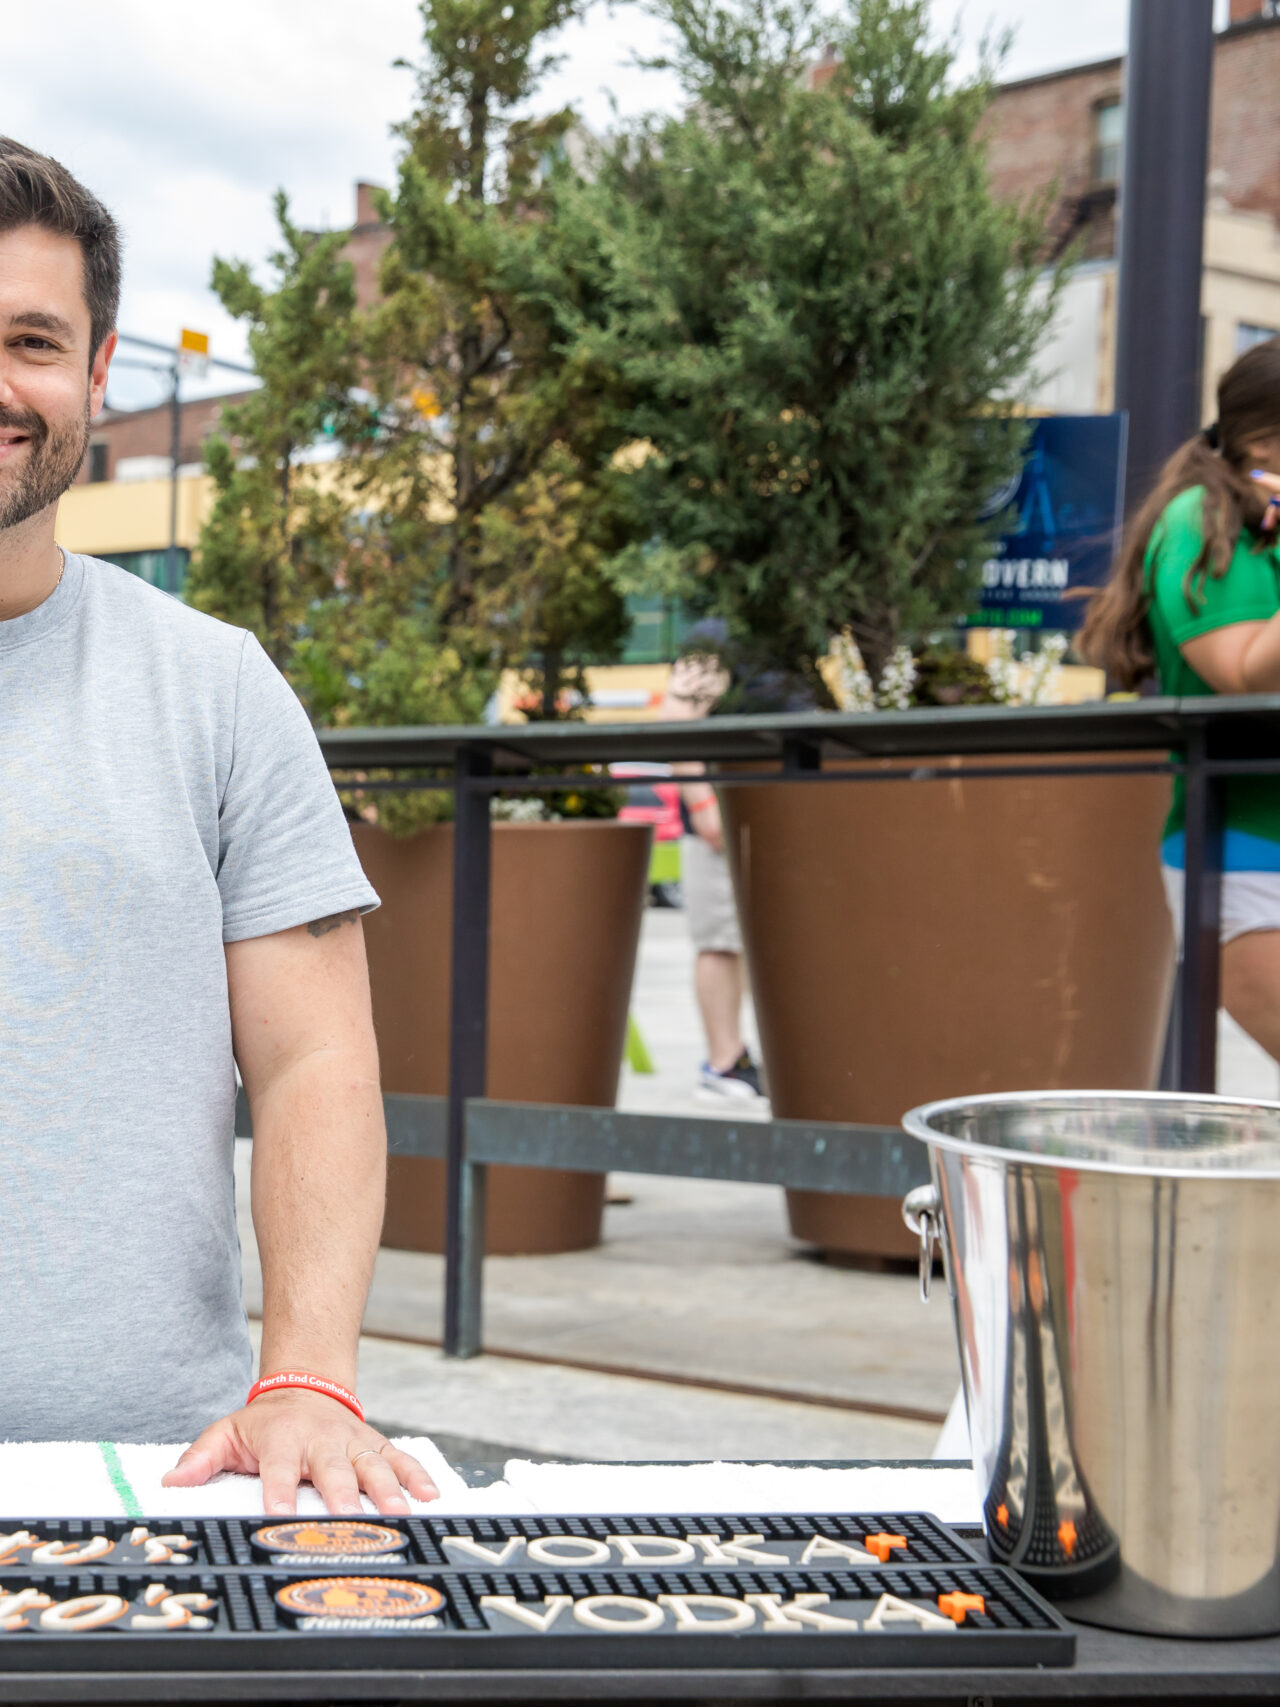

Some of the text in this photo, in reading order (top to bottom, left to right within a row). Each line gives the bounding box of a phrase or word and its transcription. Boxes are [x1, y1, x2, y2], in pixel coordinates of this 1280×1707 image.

[259, 1374, 286, 1388] North
[288, 1374, 307, 1383] End
[308, 1376, 350, 1400] Cornhole
[441, 1533, 880, 1566] VODKA
[480, 1592, 958, 1631] VODKA
